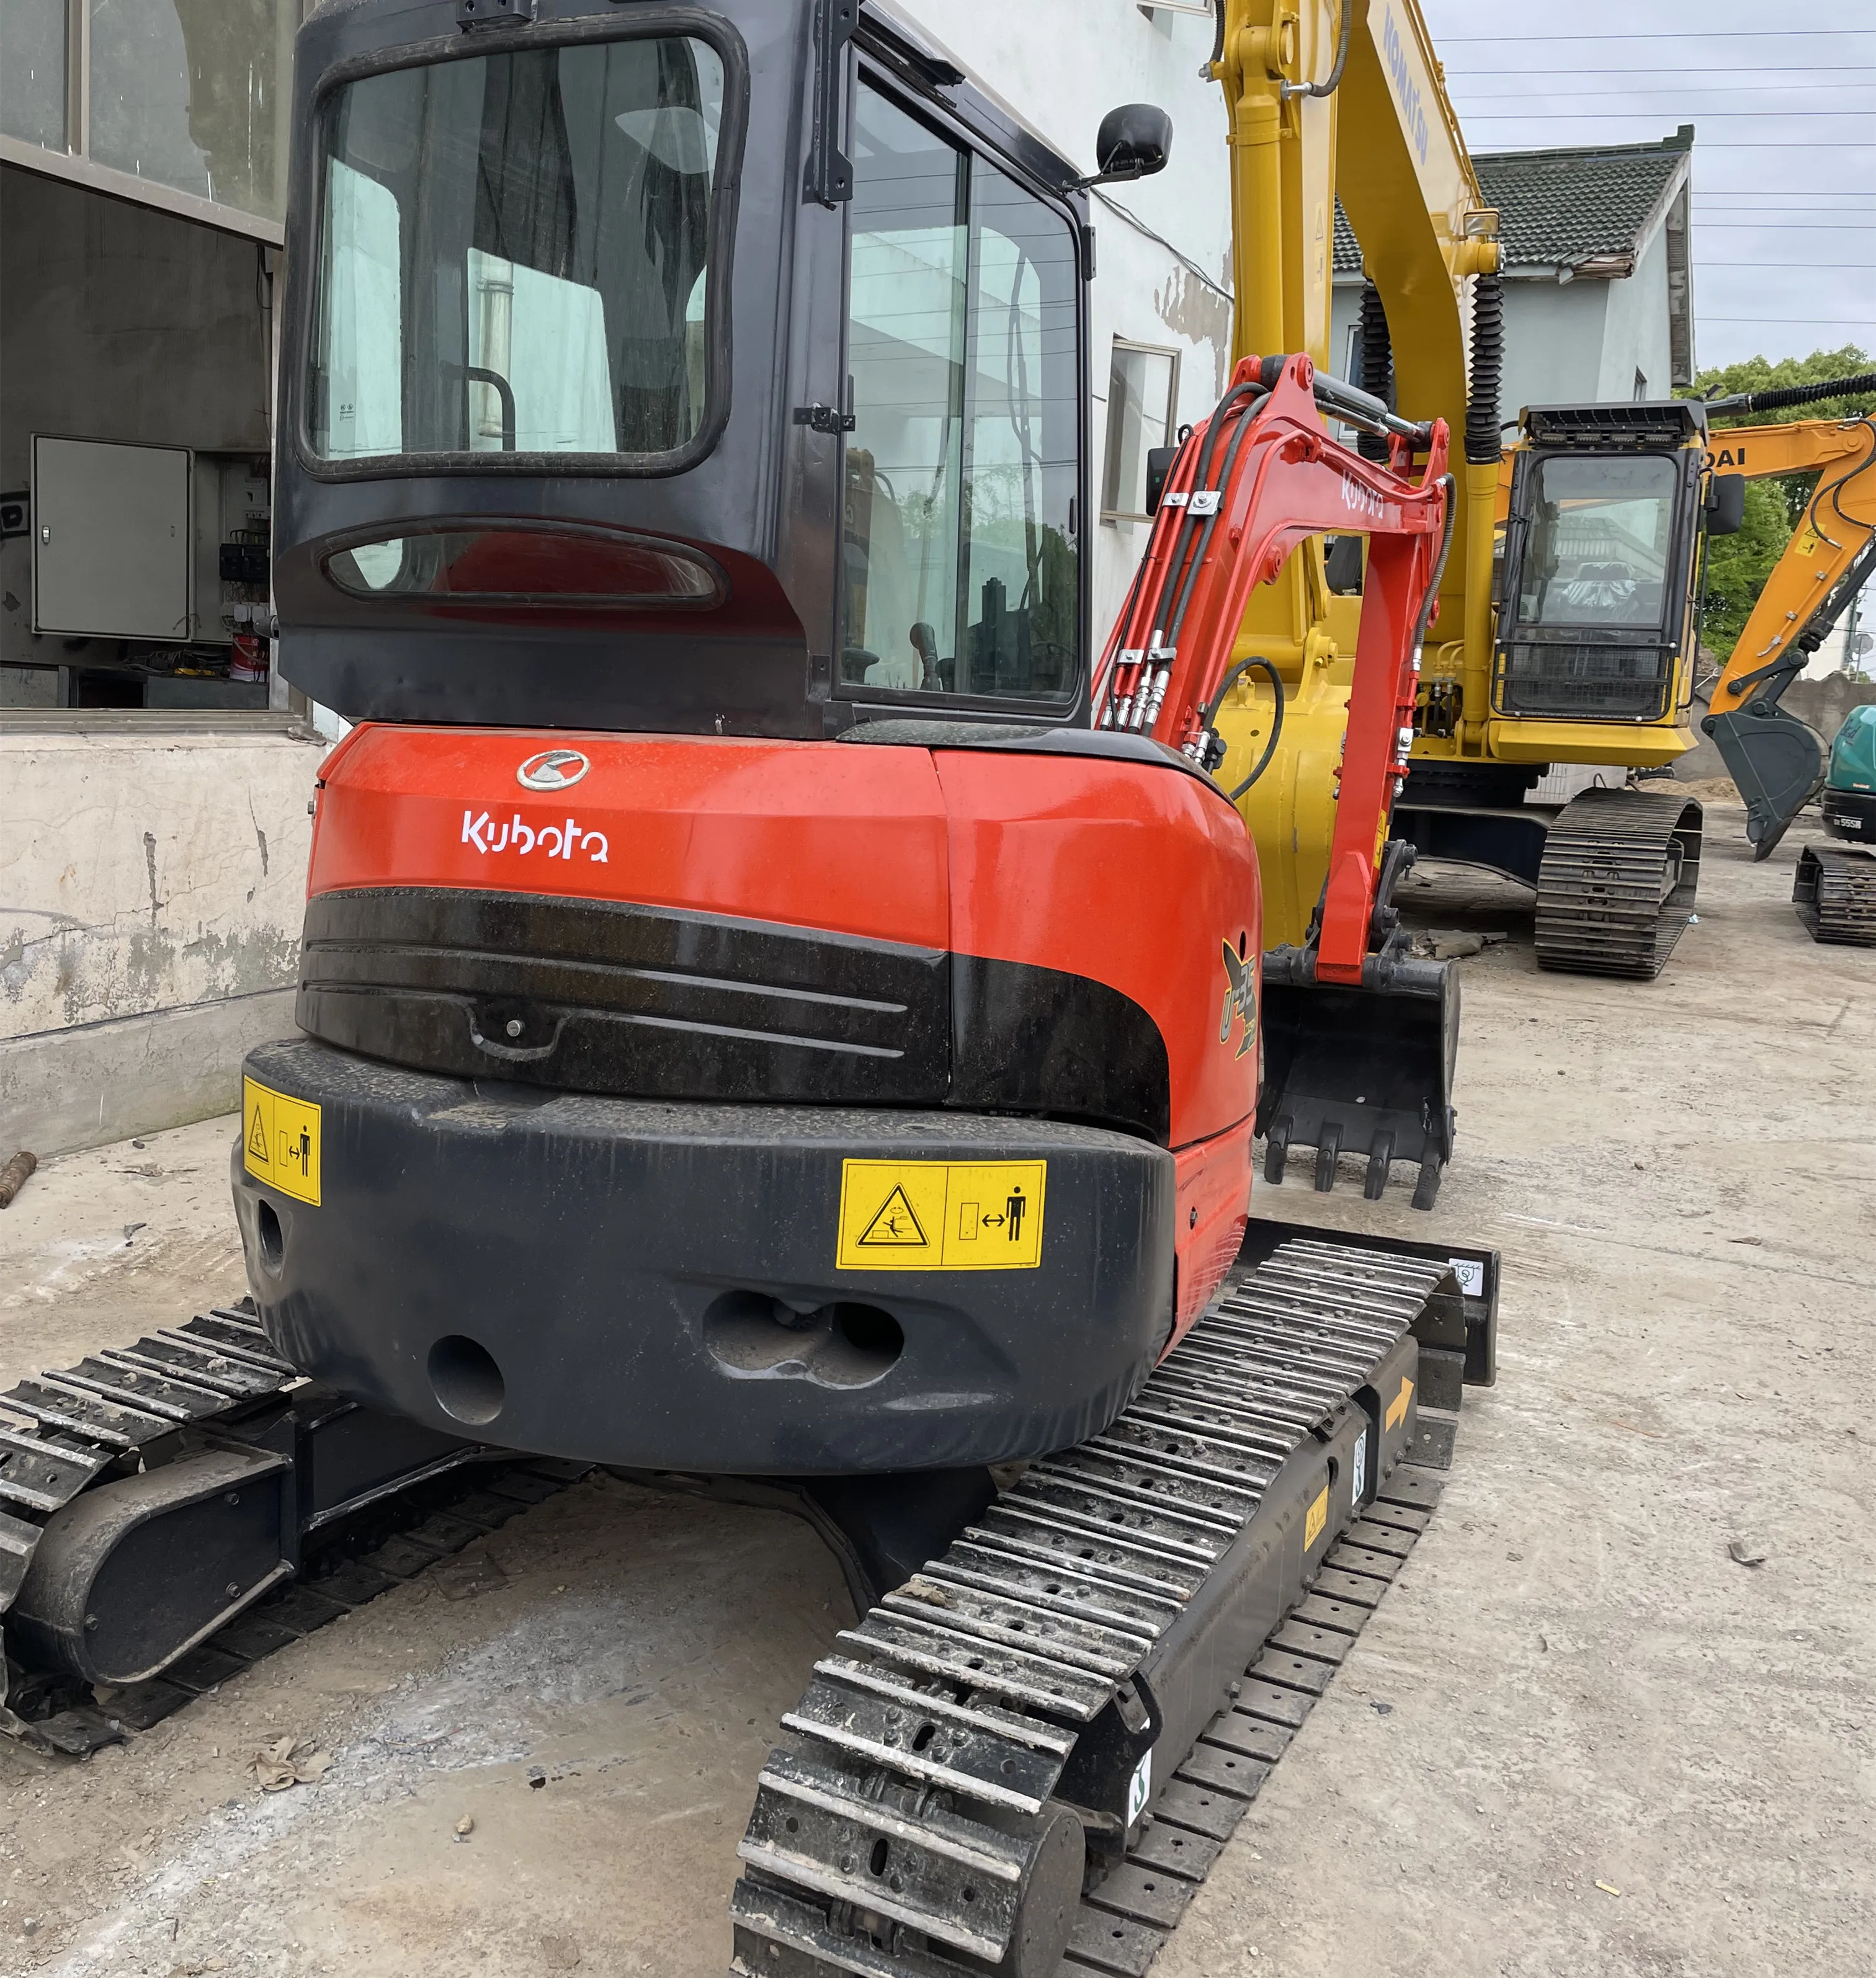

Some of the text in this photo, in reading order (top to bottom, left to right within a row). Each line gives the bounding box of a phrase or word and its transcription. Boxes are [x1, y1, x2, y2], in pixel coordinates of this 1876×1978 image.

[1383, 2, 1428, 166] KOMATSU
[1341, 469, 1384, 520] Kubota
[461, 810, 609, 863] Kubota
